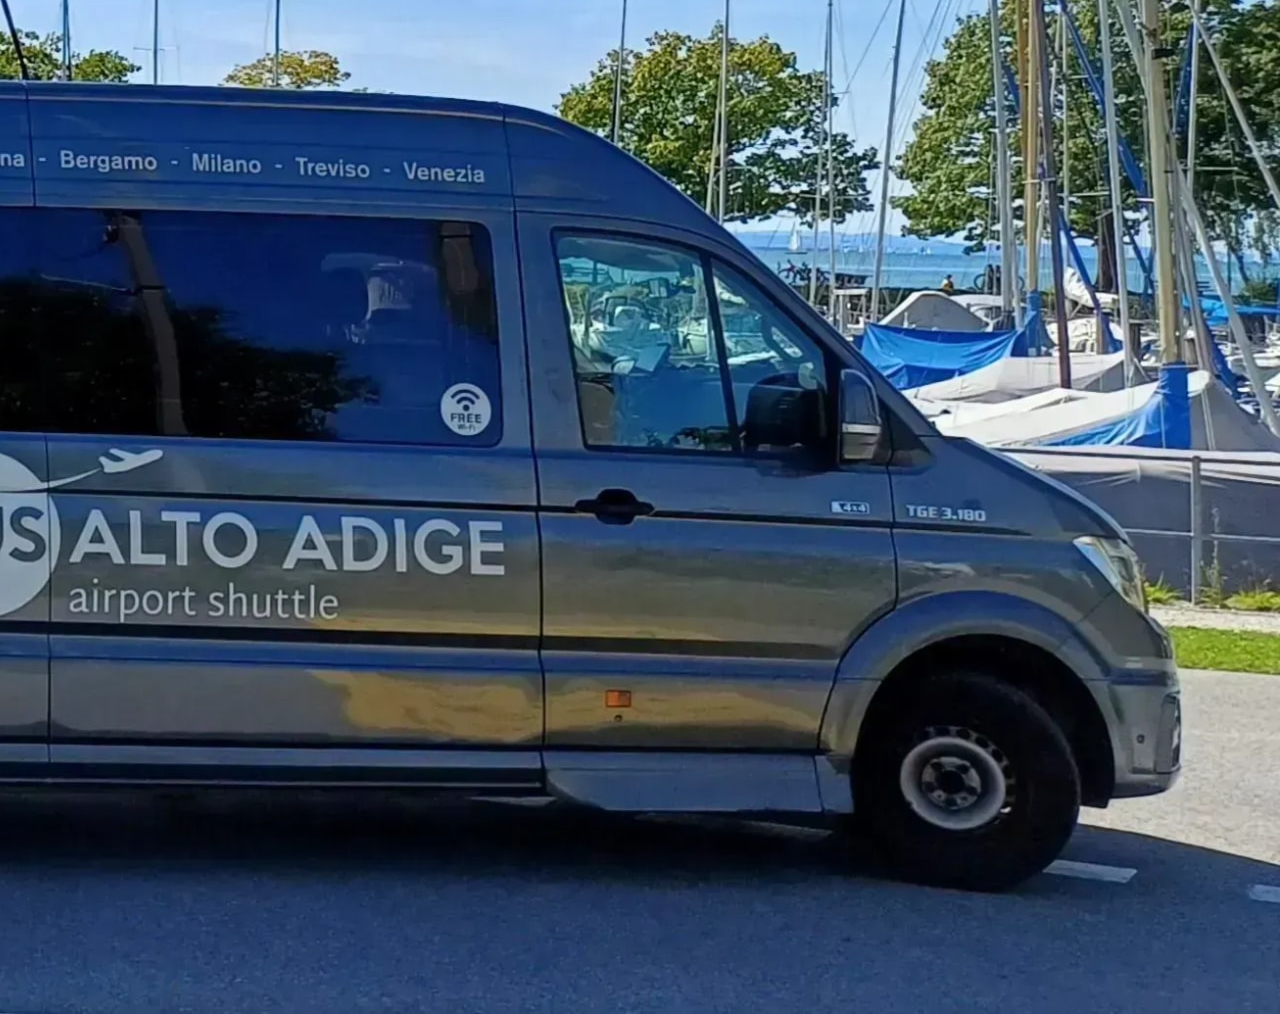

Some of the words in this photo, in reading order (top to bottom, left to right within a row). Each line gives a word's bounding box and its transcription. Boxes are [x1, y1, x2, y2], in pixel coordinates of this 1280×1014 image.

[59, 150, 158, 173] Bergamo
[191, 152, 262, 175] Milano
[295, 156, 371, 179] Treviso
[402, 161, 486, 184] Venezia
[450, 412, 483, 424] FREE
[905, 504, 938, 518] TGE
[941, 506, 987, 522] 3.180
[69, 508, 259, 569] ALTO
[282, 515, 505, 576] ADIGE
[69, 578, 197, 623] airport
[208, 582, 339, 620] shuttle
